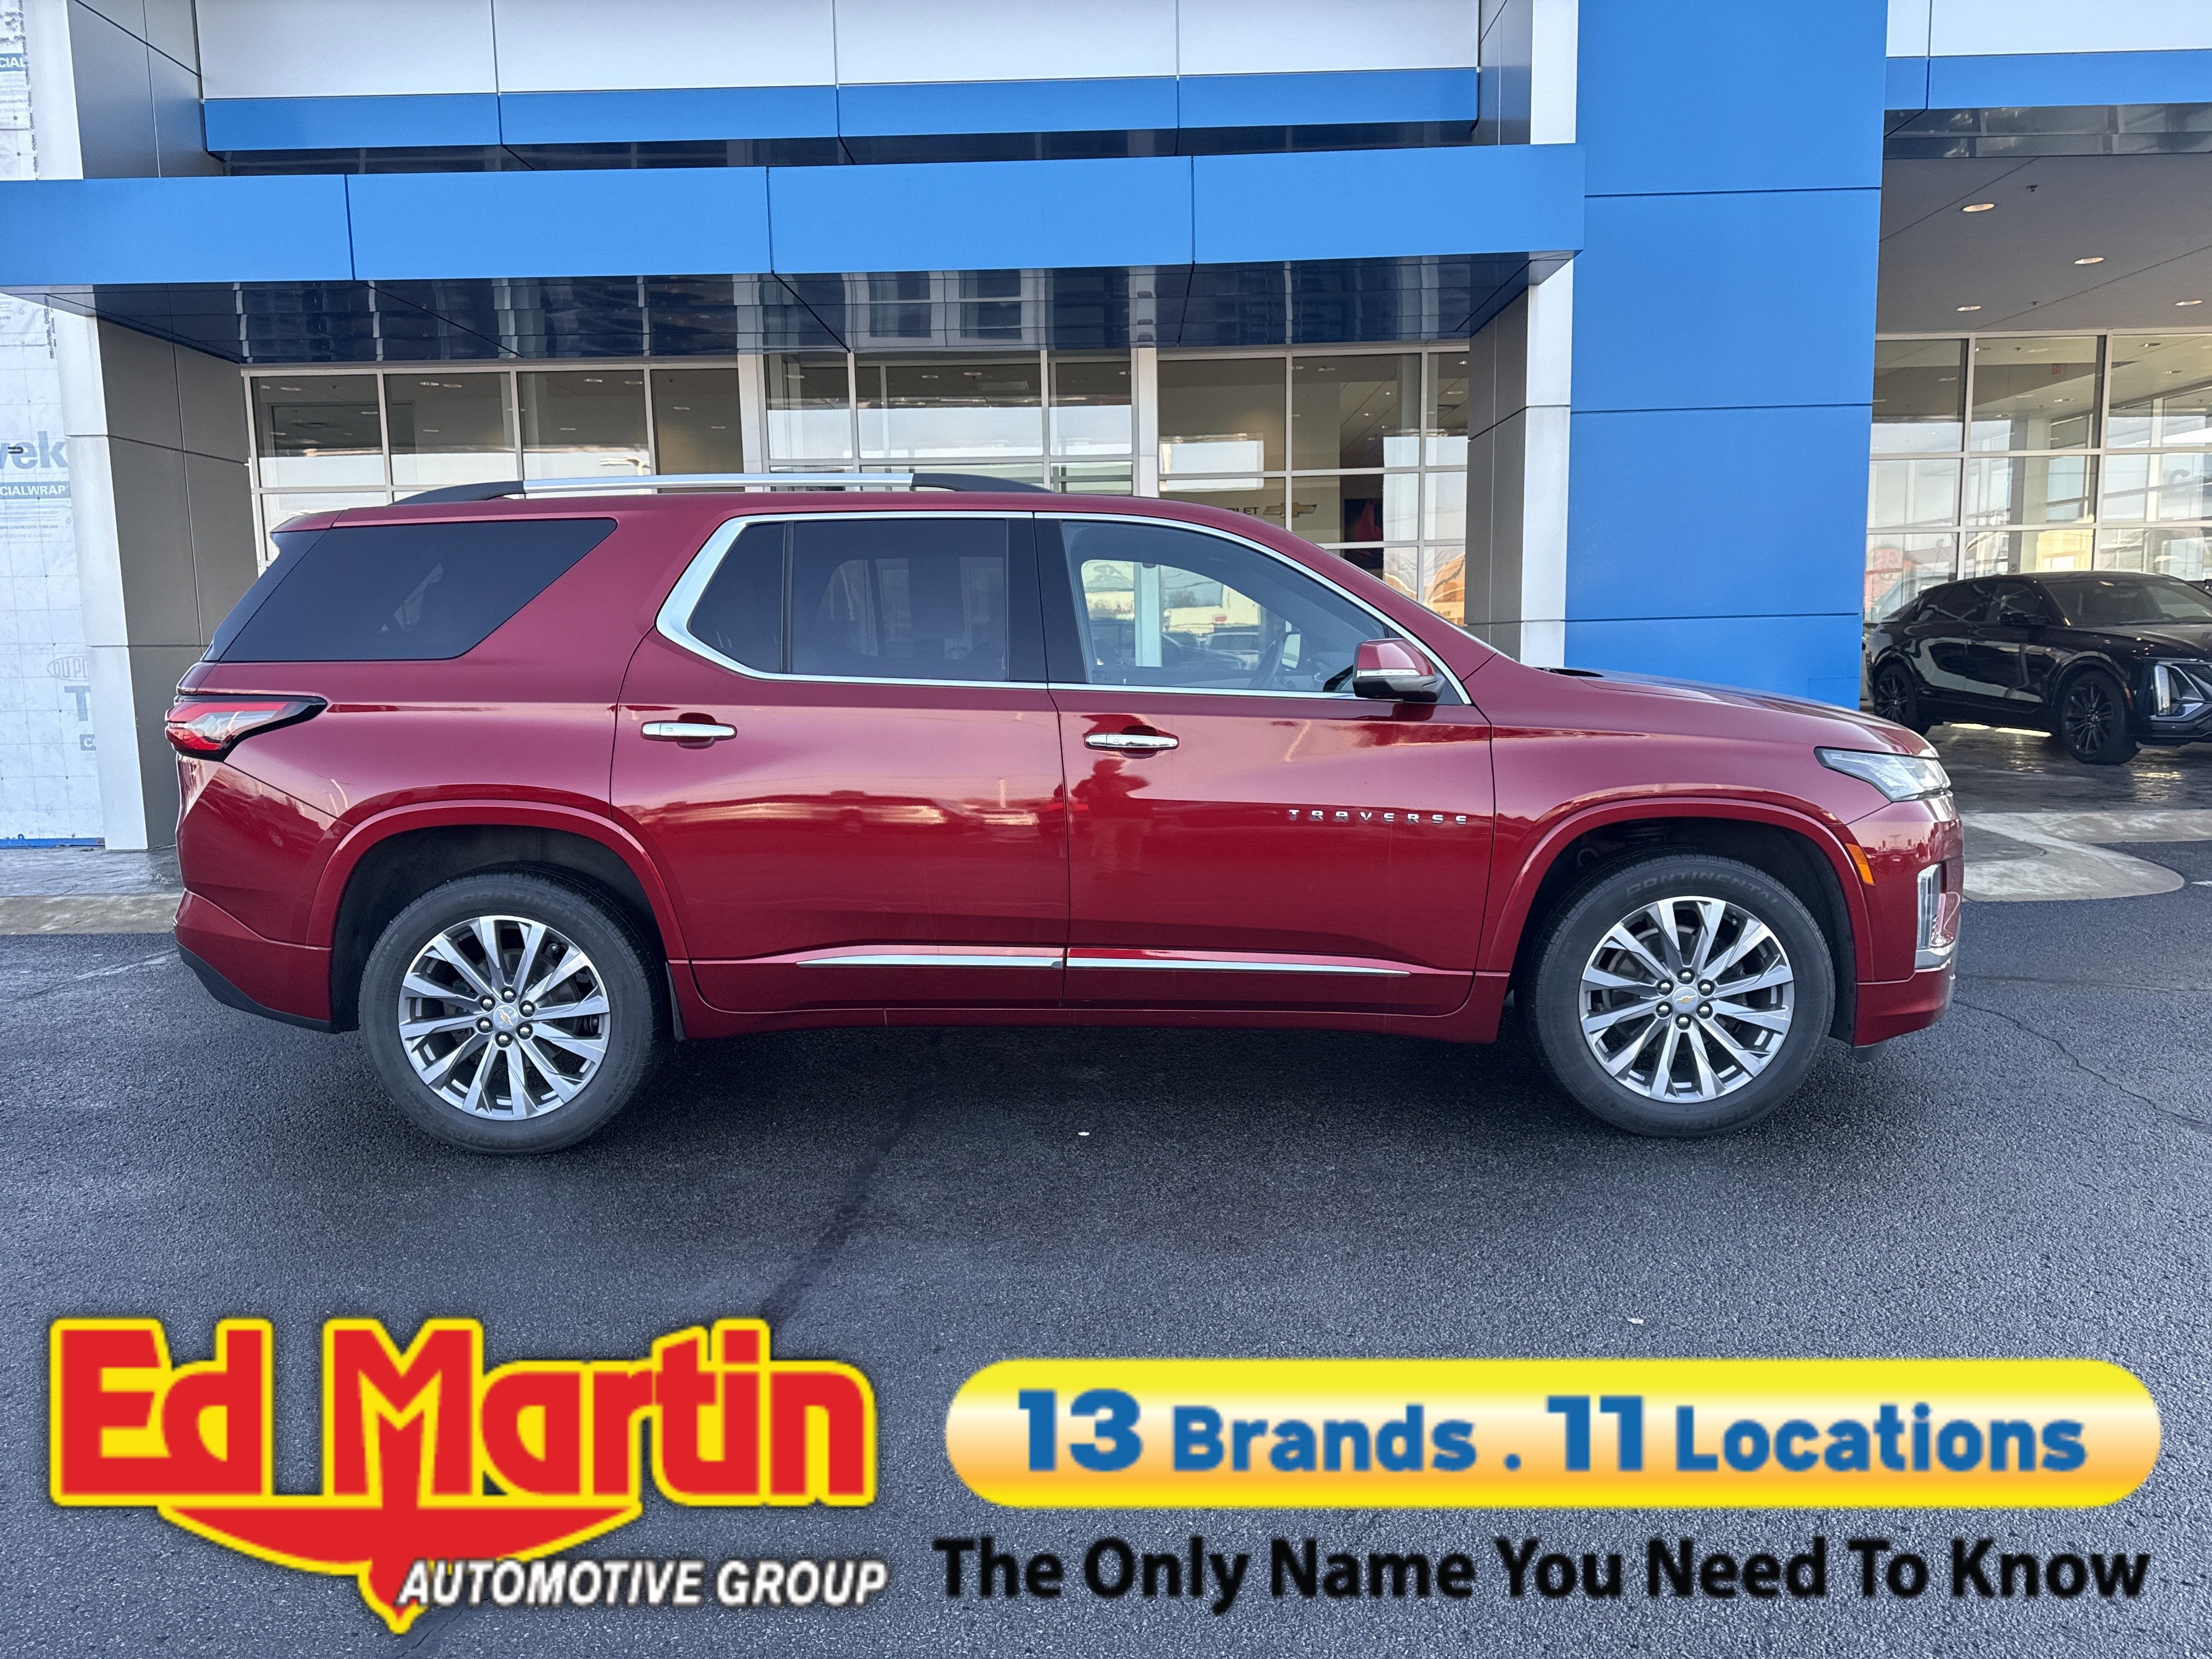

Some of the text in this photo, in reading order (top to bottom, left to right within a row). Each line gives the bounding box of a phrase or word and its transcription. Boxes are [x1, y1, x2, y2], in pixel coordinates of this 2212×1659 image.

[0, 485, 66, 495] CIALWRAP
[64, 685, 90, 721] T
[1289, 809, 1467, 825] TRAVERSE
